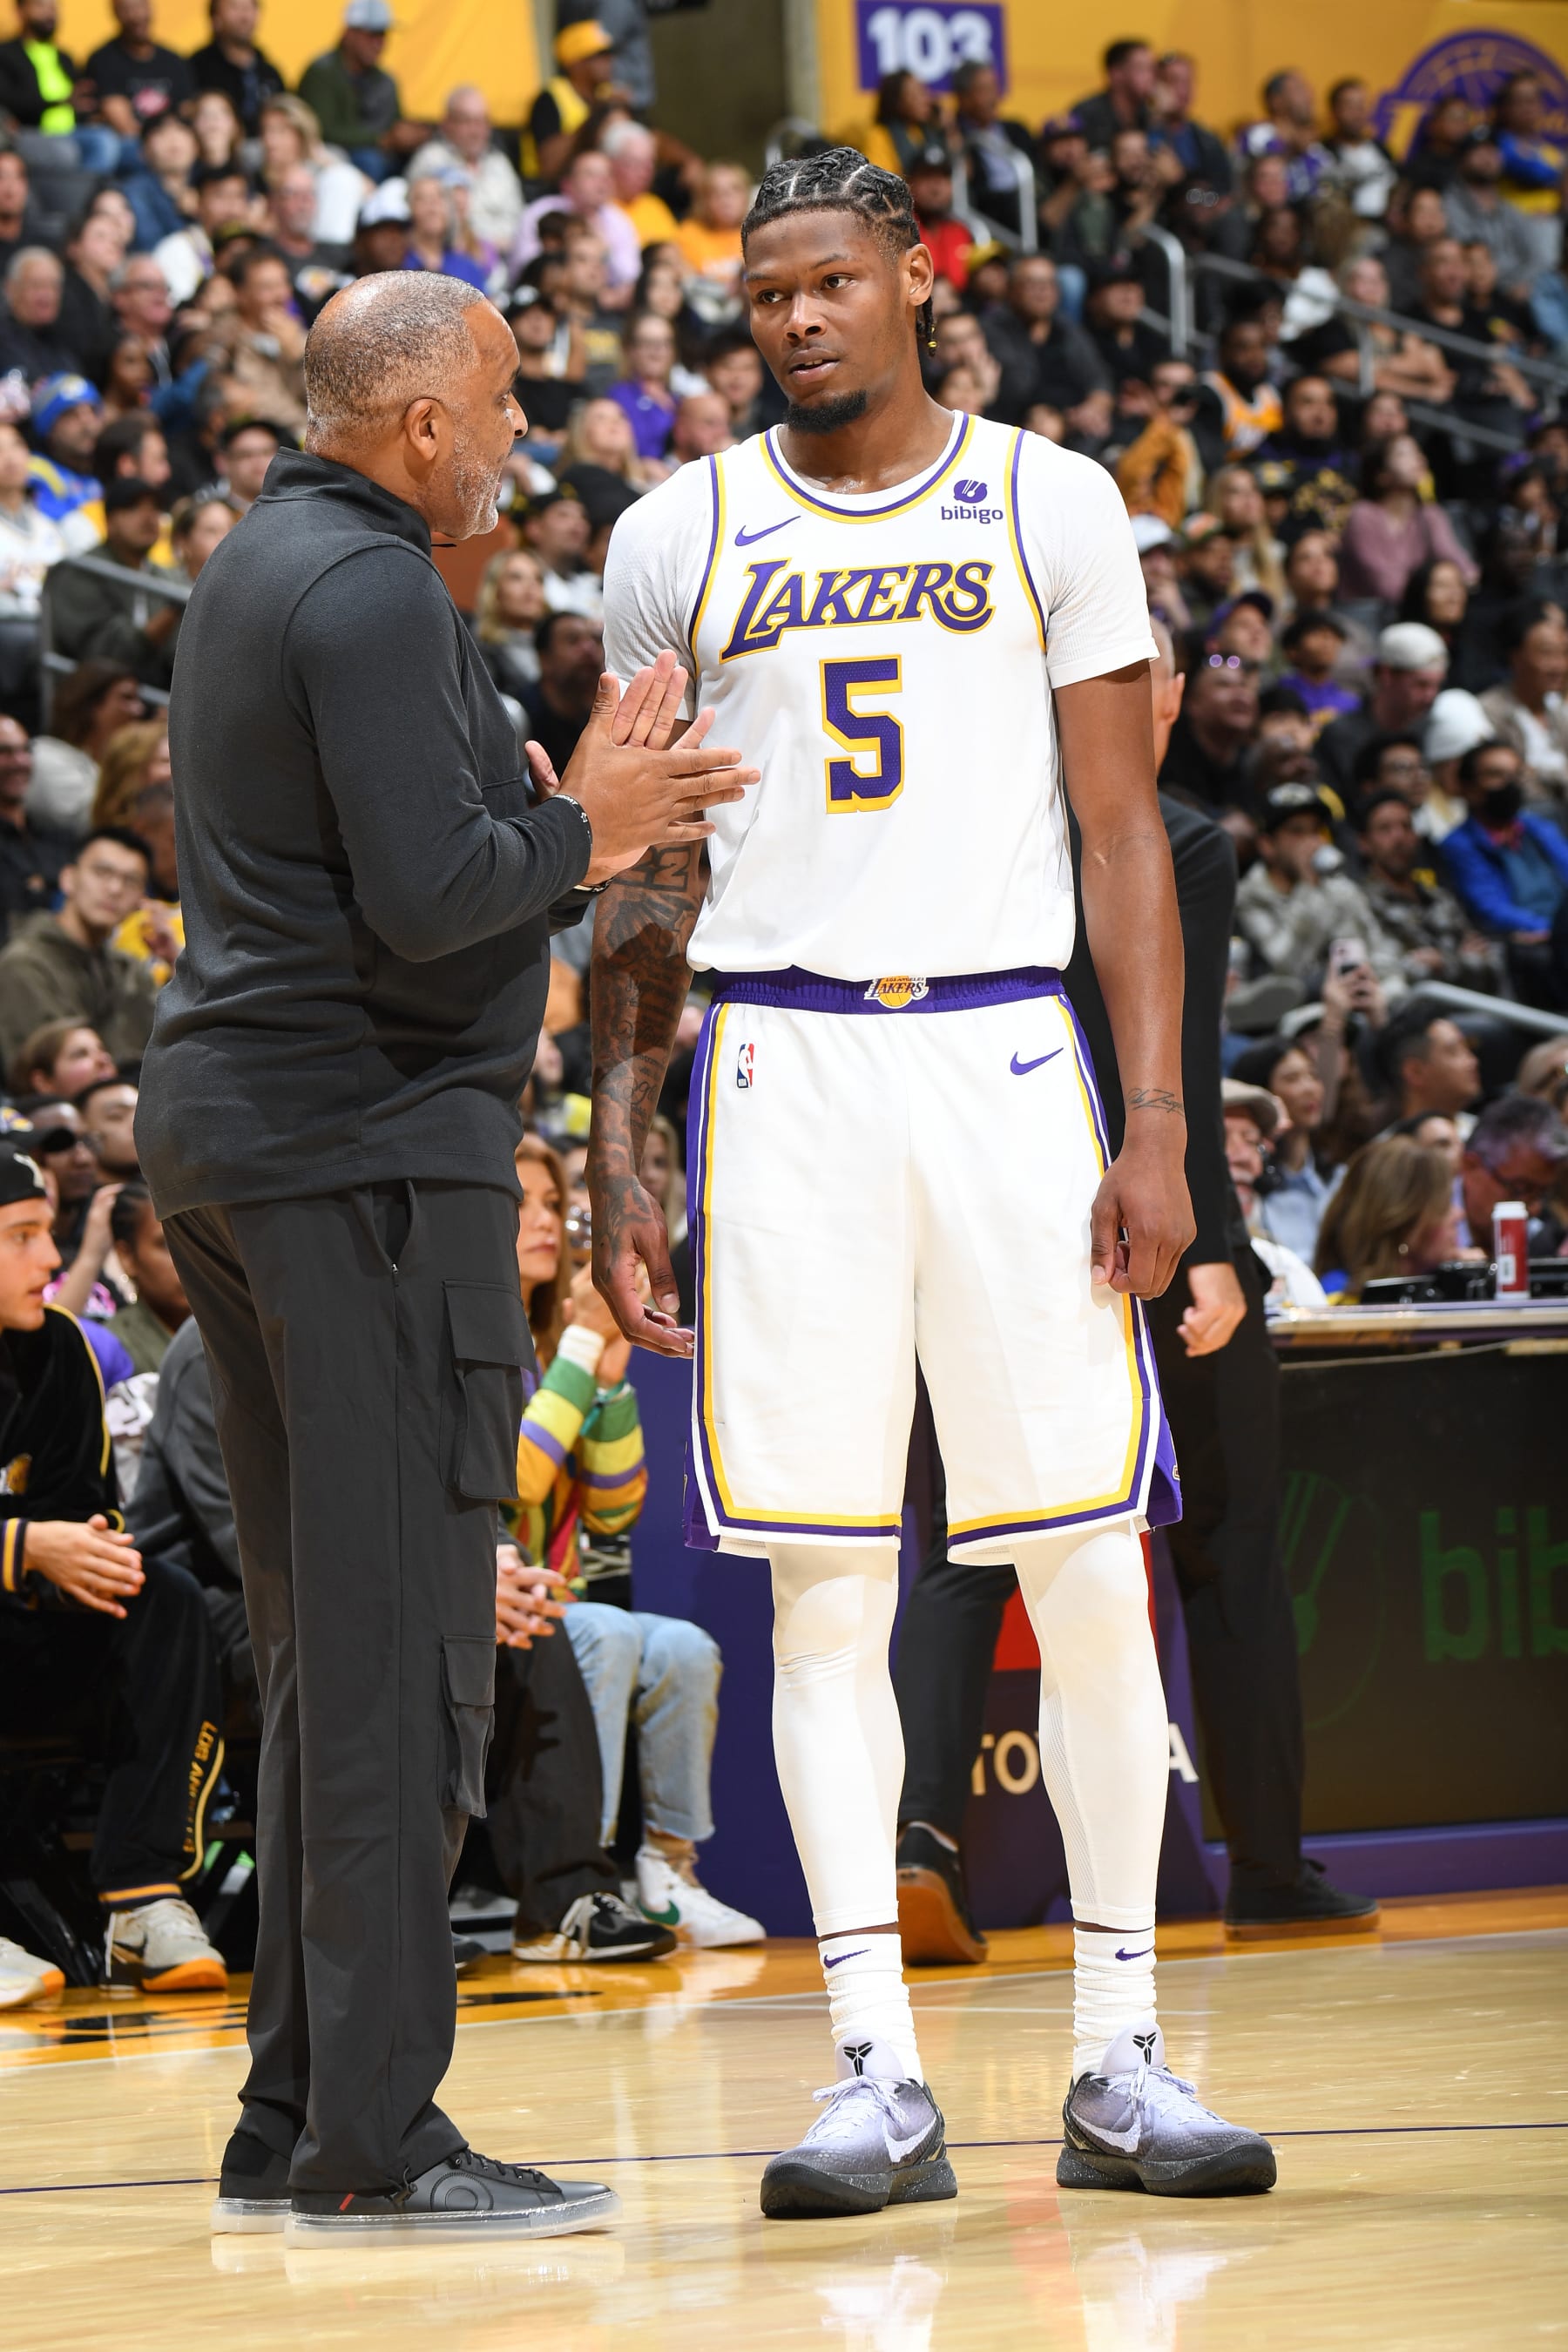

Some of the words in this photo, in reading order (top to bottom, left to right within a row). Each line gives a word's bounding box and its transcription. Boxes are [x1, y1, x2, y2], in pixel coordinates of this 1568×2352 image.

[868, 7, 993, 83] 103
[940, 505, 1004, 524] bibigo
[719, 558, 997, 666] LAKERS
[819, 653, 906, 814] 5
[868, 977, 928, 999] LAKERS
[1420, 1504, 1568, 1665] bib
